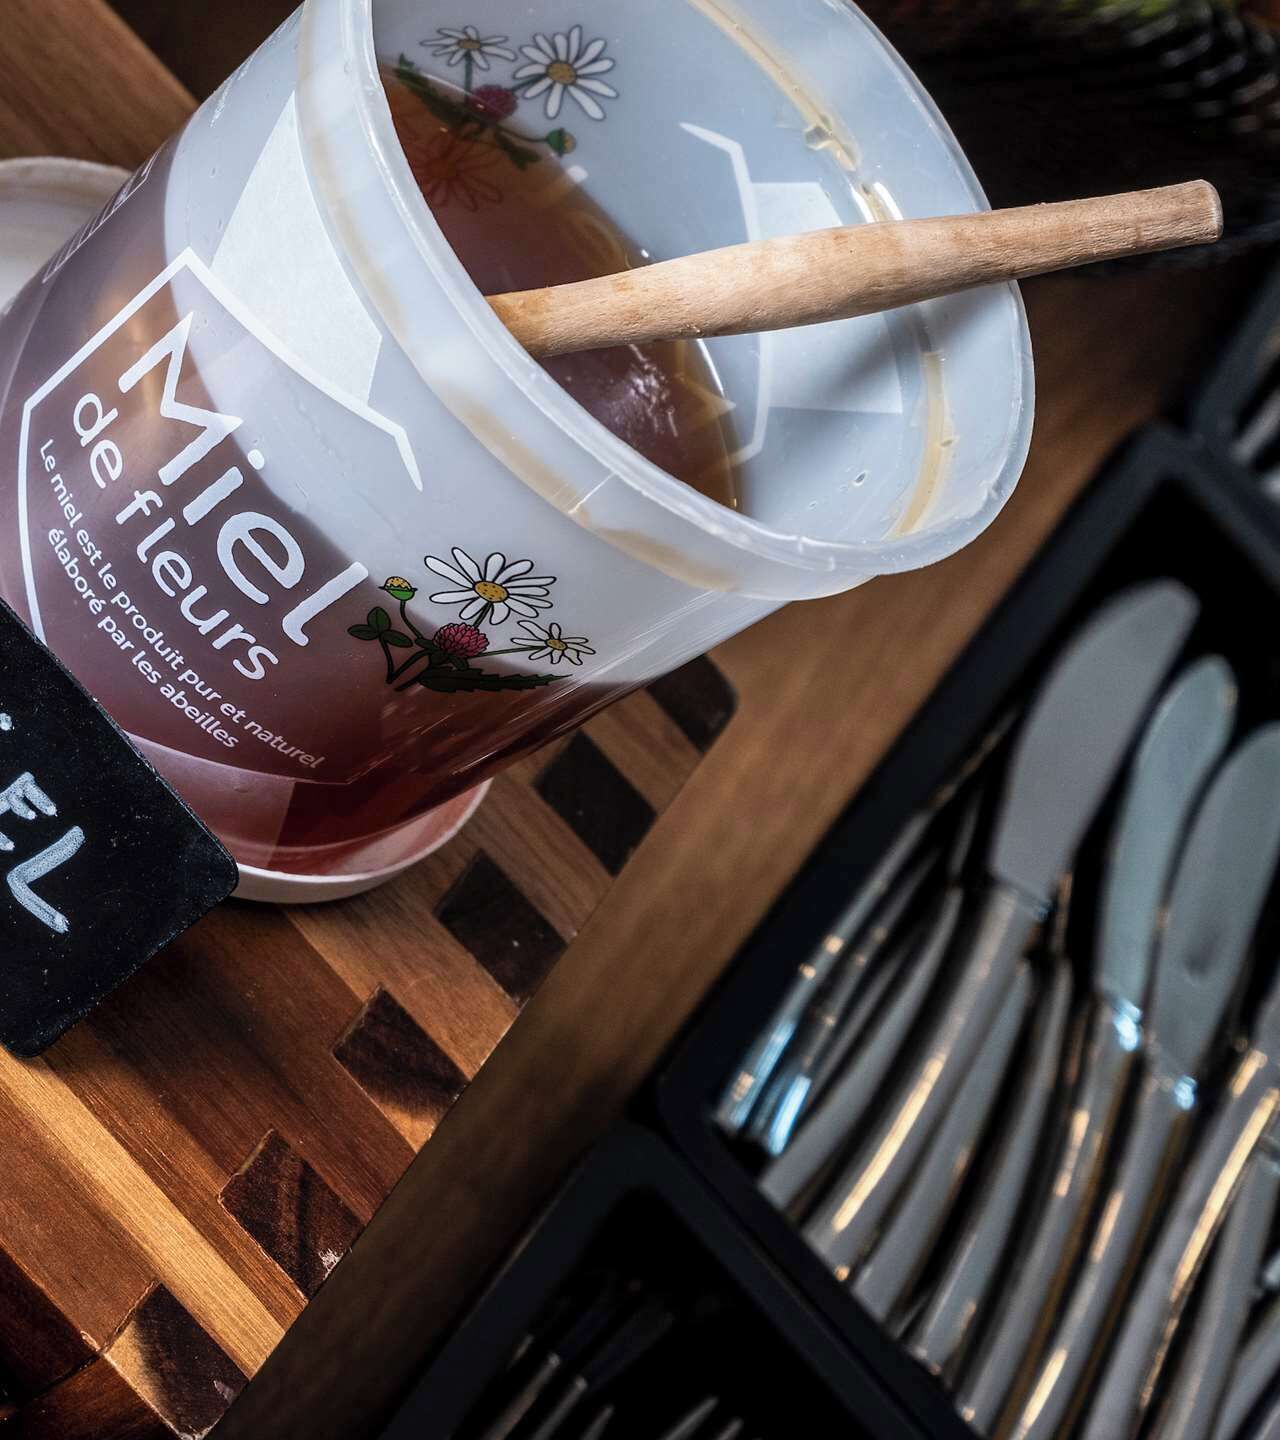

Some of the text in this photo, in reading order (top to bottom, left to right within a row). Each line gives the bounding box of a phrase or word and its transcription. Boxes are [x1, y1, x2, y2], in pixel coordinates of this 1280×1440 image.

[40, 438, 326, 769] Le miel est le produit pur et naturel
[72, 392, 279, 681] de fleurs
[117, 311, 370, 648] Miel
[48, 527, 241, 750] élaboré par les abeilles
